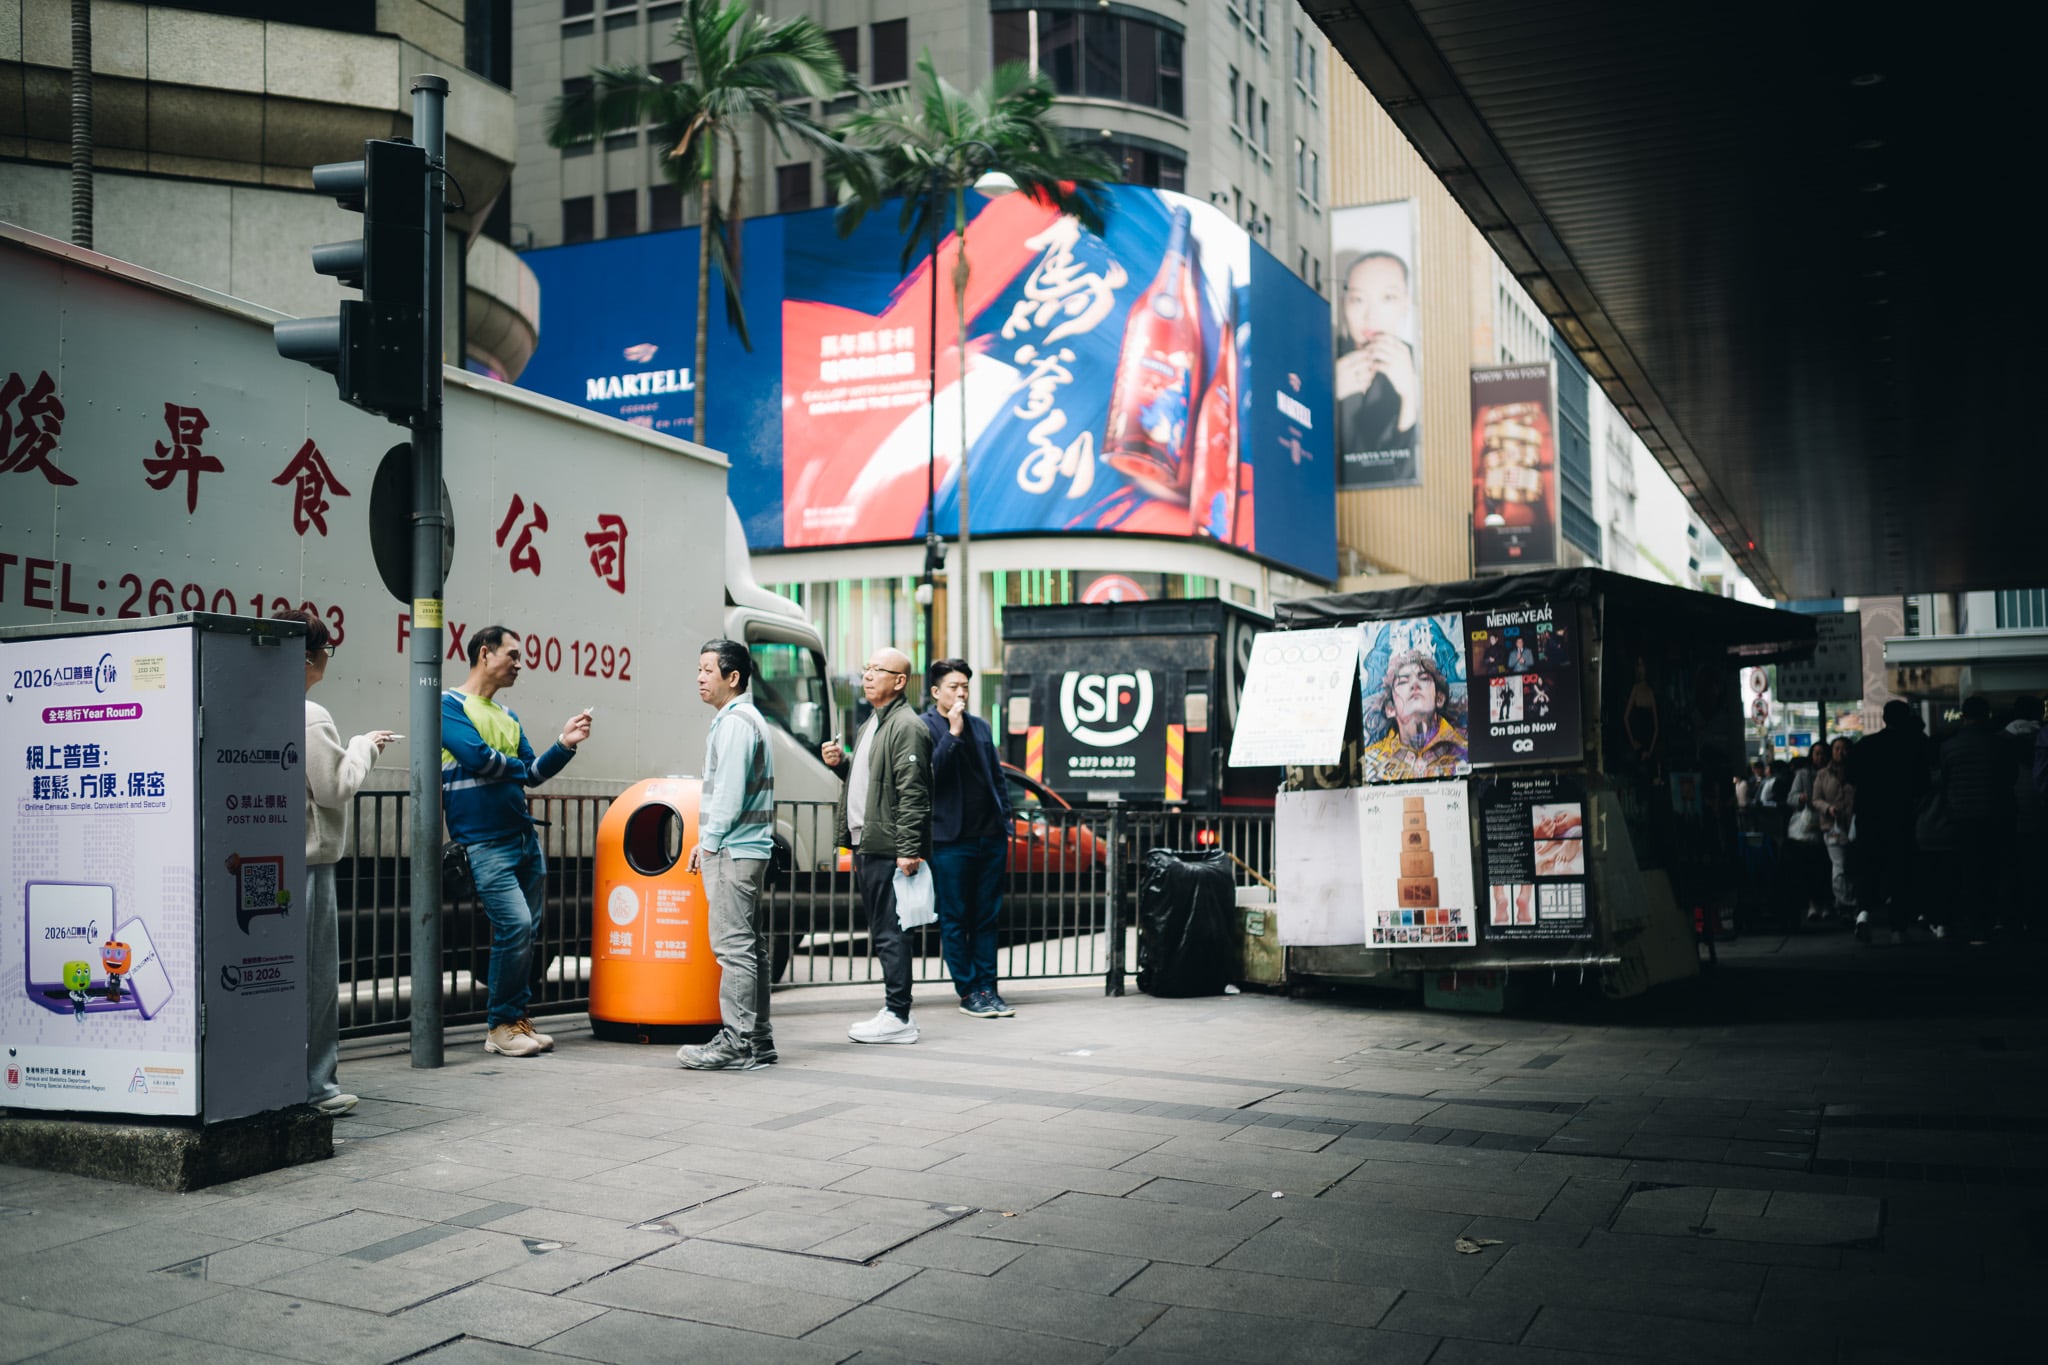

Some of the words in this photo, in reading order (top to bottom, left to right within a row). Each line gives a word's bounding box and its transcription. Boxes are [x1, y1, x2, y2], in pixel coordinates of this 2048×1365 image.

[586, 368, 695, 401] MARTELL
[0, 553, 106, 616] TEL:
[1487, 611, 1511, 628] MEN
[1522, 607, 1553, 623] YEAR
[397, 612, 466, 662] FX
[571, 640, 631, 681] 1292
[13, 669, 52, 689] 2026
[53, 666, 93, 680] 人口普查
[1077, 673, 1136, 723] SF
[82, 707, 104, 719] Year
[106, 705, 136, 717] Round
[1490, 726, 1505, 736] On
[1507, 724, 1530, 735] Sale
[1532, 722, 1557, 732] Now
[217, 749, 248, 763] 2026
[25, 803, 44, 811] Online
[94, 801, 129, 810] Convenient
[143, 800, 166, 808] Secure
[227, 815, 250, 825] POST
[253, 815, 266, 824] NO
[268, 814, 288, 824] BILL
[45, 927, 66, 939] 2026
[255, 967, 281, 980] 2026
